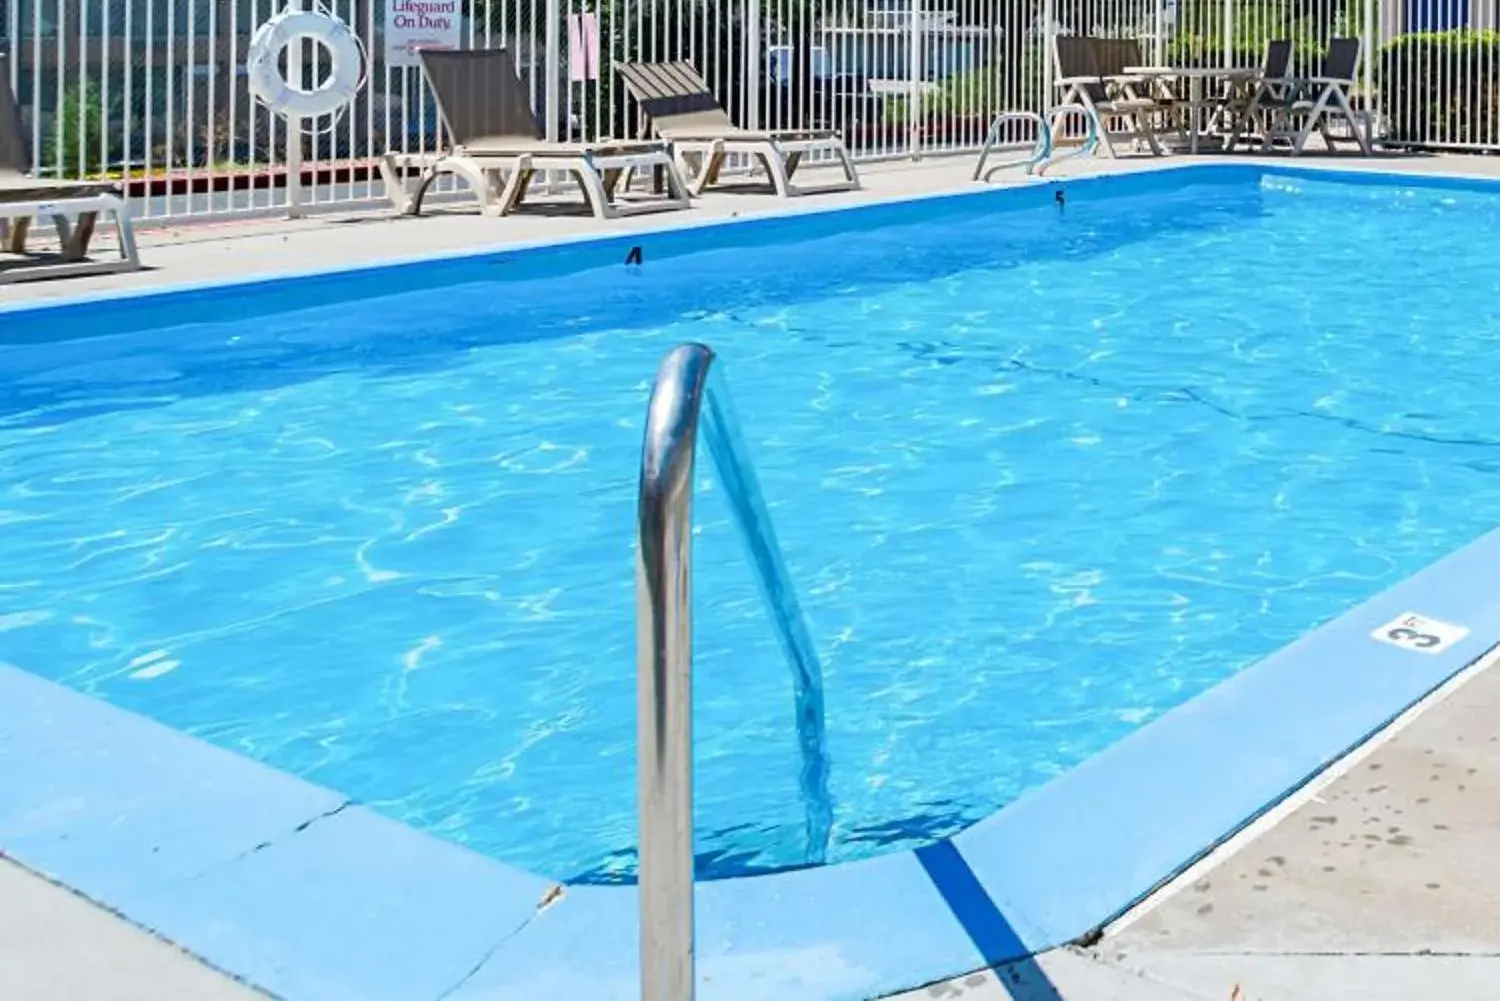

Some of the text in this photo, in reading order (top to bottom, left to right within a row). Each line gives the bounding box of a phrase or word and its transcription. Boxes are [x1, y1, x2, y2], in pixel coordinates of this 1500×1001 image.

[393, 0, 455, 17] Lifeguard
[394, 14, 451, 30] On Duty
[1388, 628, 1441, 647] 3
